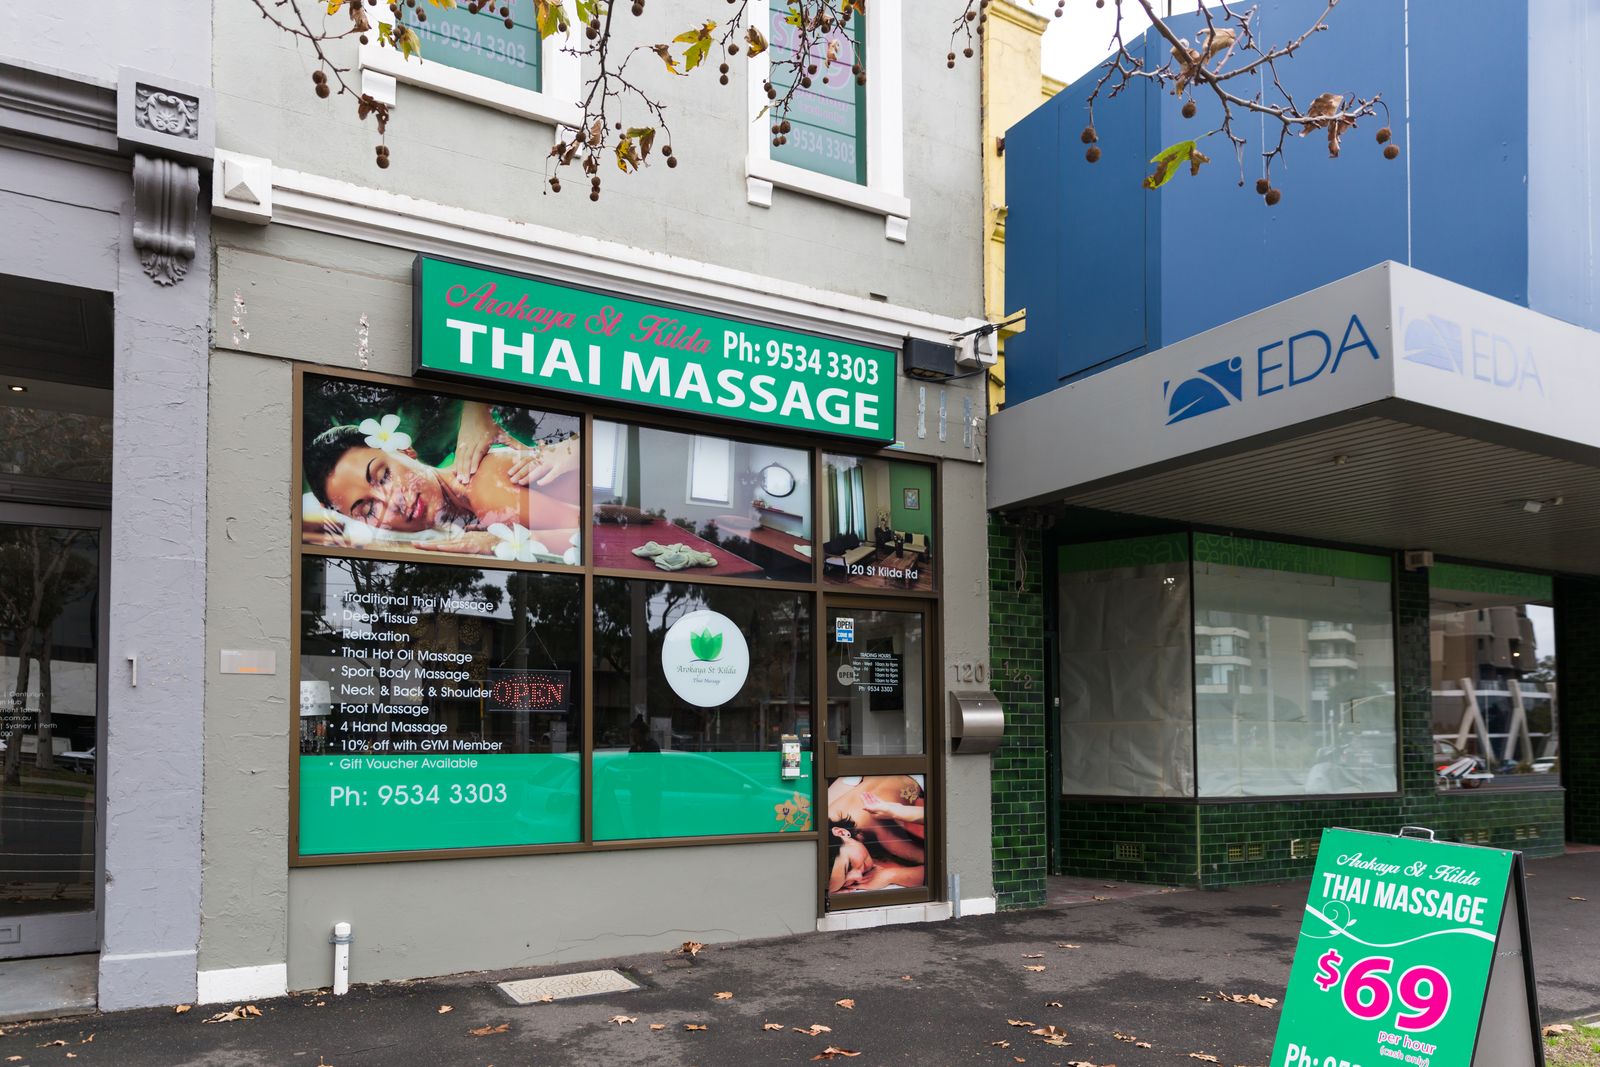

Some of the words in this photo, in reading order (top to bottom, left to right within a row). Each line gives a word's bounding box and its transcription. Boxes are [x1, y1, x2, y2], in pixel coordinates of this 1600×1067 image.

[440, 20, 482, 55] 9534
[486, 34, 526, 69] 3303
[793, 128, 824, 154] 9534
[826, 136, 855, 165] 3303
[446, 282, 577, 333] Arokaya
[585, 306, 621, 337] St
[630, 314, 712, 355] Kilda
[723, 330, 760, 364] Ph:
[766, 339, 820, 375] 9534
[826, 351, 879, 385] 3303
[1257, 314, 1380, 397] EDA
[1472, 330, 1545, 398] EDA
[446, 319, 600, 386] THAI
[620, 352, 879, 430] MASSAGE
[847, 564, 864, 575] 120
[867, 565, 875, 576] St
[878, 567, 902, 579] Kilda
[905, 569, 918, 579] Rd
[344, 592, 408, 606] Traditional
[412, 595, 436, 608] Thai
[440, 598, 493, 611] Massage
[343, 611, 378, 624] Deep
[383, 613, 418, 624] Tissue
[837, 620, 853, 629] OPEN
[342, 629, 410, 642] Relaxation
[342, 647, 368, 659] Thai
[372, 648, 393, 660] Hot
[397, 650, 413, 661] Oil
[417, 651, 472, 664] Massage
[341, 666, 374, 678] Sport
[380, 668, 411, 680] Body
[415, 669, 469, 681] Massage
[677, 665, 706, 675] Arokaya
[708, 666, 715, 674] St
[717, 666, 737, 675] Kilda
[839, 671, 854, 679] OPEN
[953, 661, 985, 682] 120
[1003, 661, 1032, 689] 122
[341, 684, 374, 696] Neck
[381, 686, 390, 696] &
[394, 686, 425, 697] Back
[428, 687, 437, 697] &
[441, 687, 492, 698] Shoulder
[494, 681, 564, 704] OPEN
[341, 703, 368, 714] Foot
[372, 703, 429, 716] Massage
[341, 722, 348, 732] 4
[353, 721, 387, 732] Hand
[391, 721, 447, 734] Massage
[341, 740, 369, 751] 10%
[373, 739, 390, 751] off
[393, 739, 417, 751] with
[421, 740, 449, 751] GYM
[452, 739, 502, 751] Member
[340, 758, 363, 770] Gift
[366, 758, 418, 769] Voucher
[421, 758, 478, 769] Available
[330, 786, 367, 806] Ph:
[378, 785, 439, 806] 9534
[450, 783, 507, 803] 3303
[1336, 853, 1401, 877] Arokaya
[1404, 861, 1427, 878] St
[1429, 864, 1481, 887] Kilda
[1322, 872, 1370, 905] THAI
[1373, 881, 1488, 926] MASSAGE
[1377, 1030, 1402, 1046] per
[1403, 1034, 1436, 1055] hour
[1379, 1045, 1404, 1060] (cash
[1405, 1050, 1430, 1067] only)
